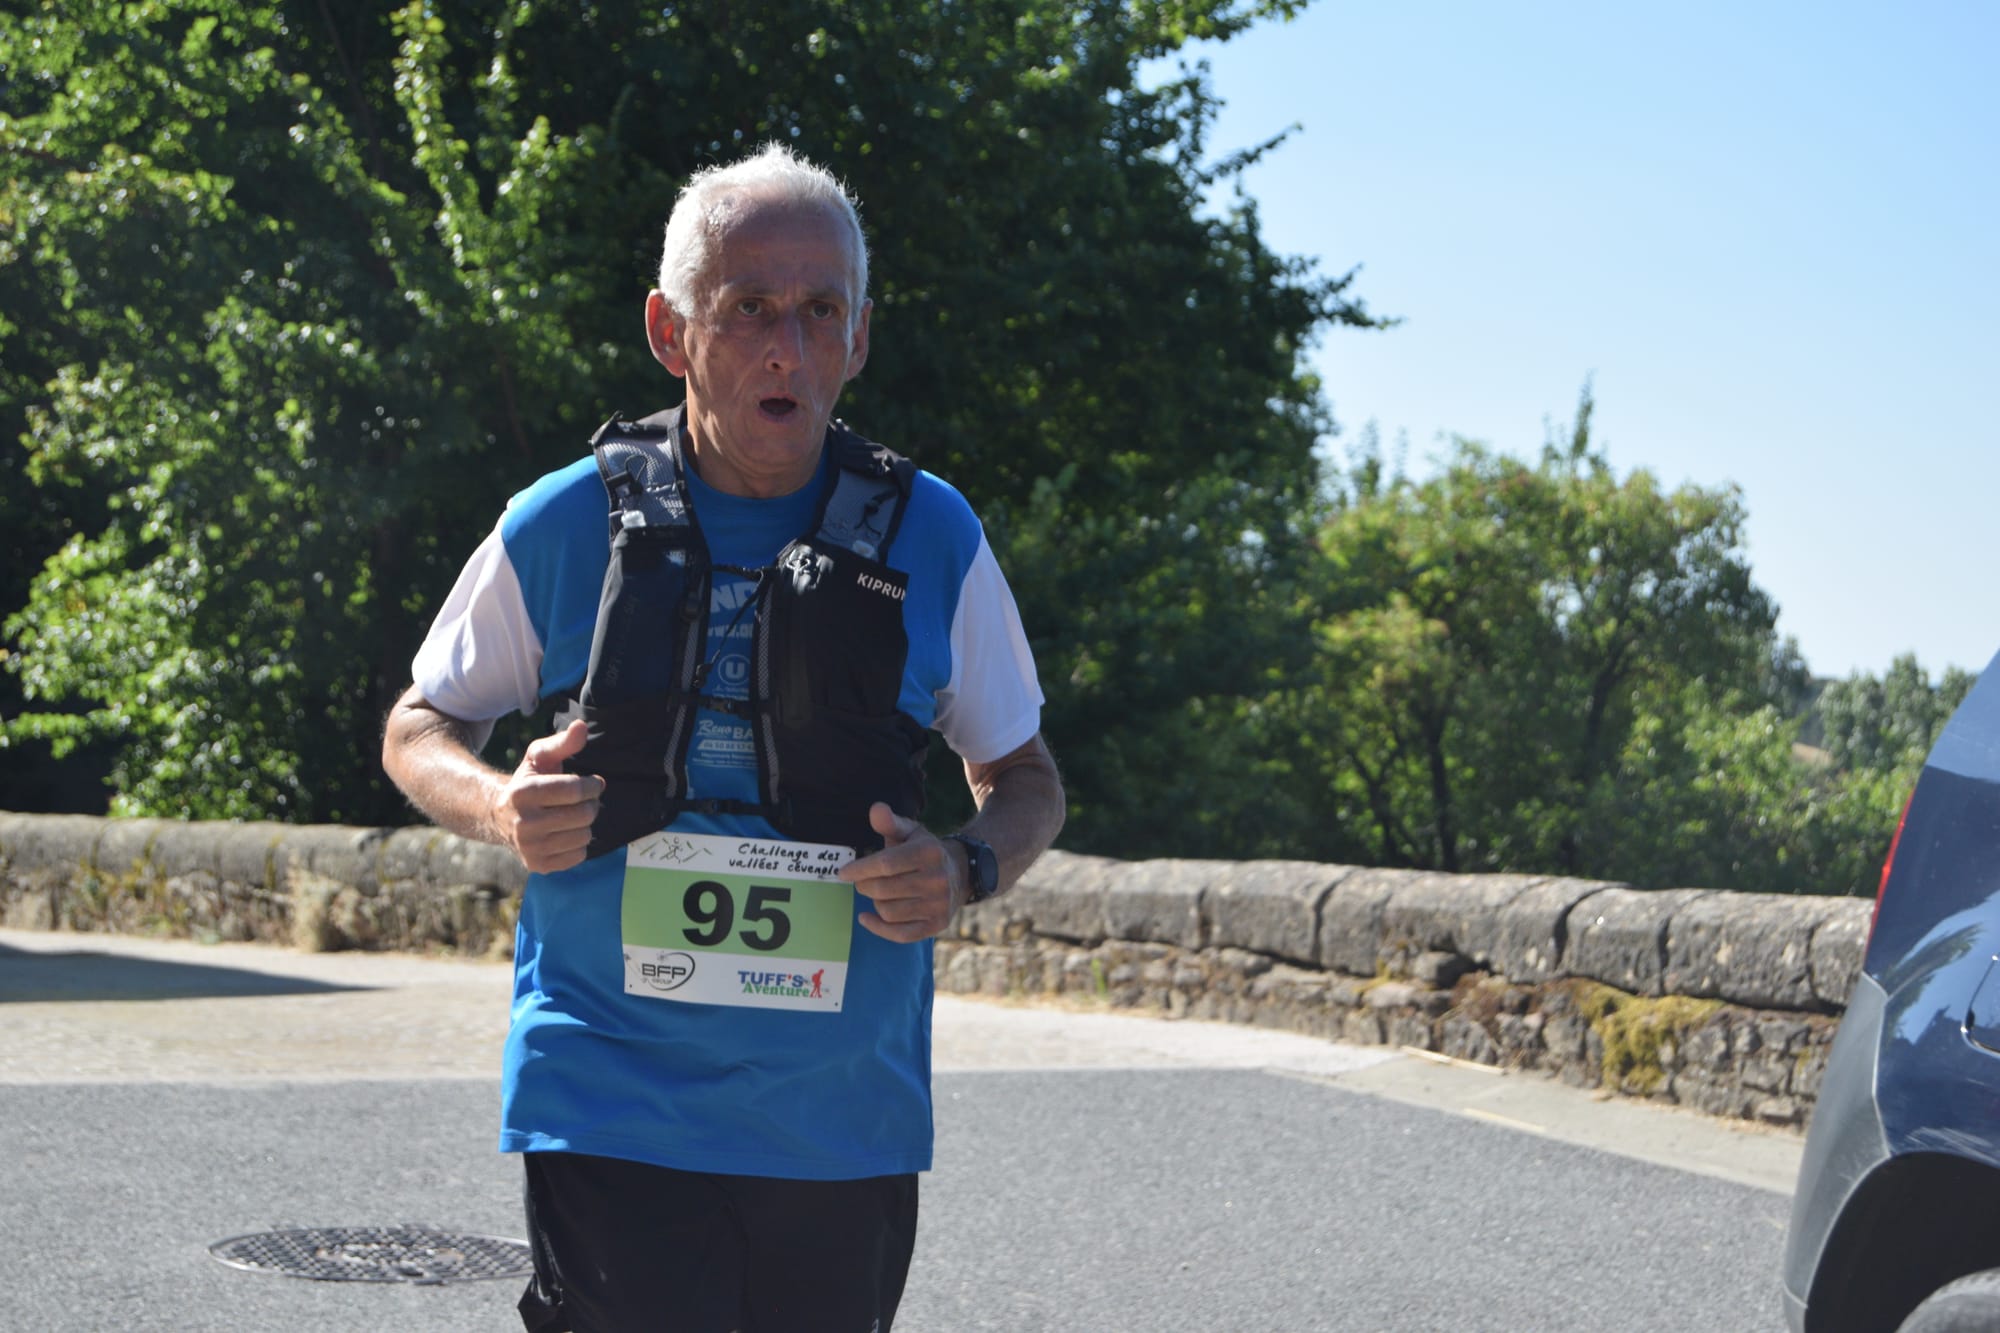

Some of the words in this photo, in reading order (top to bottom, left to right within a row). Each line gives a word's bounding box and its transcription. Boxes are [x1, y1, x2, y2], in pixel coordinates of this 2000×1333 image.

[725, 661, 745, 679] U
[738, 843, 809, 862] Challenge
[817, 849, 840, 861] des
[729, 857, 779, 870] vallées
[787, 861, 840, 876] cévenole
[682, 880, 791, 951] 95
[641, 963, 687, 979] BFP
[738, 970, 804, 988] TUFF'S
[742, 981, 810, 998] Aventure
